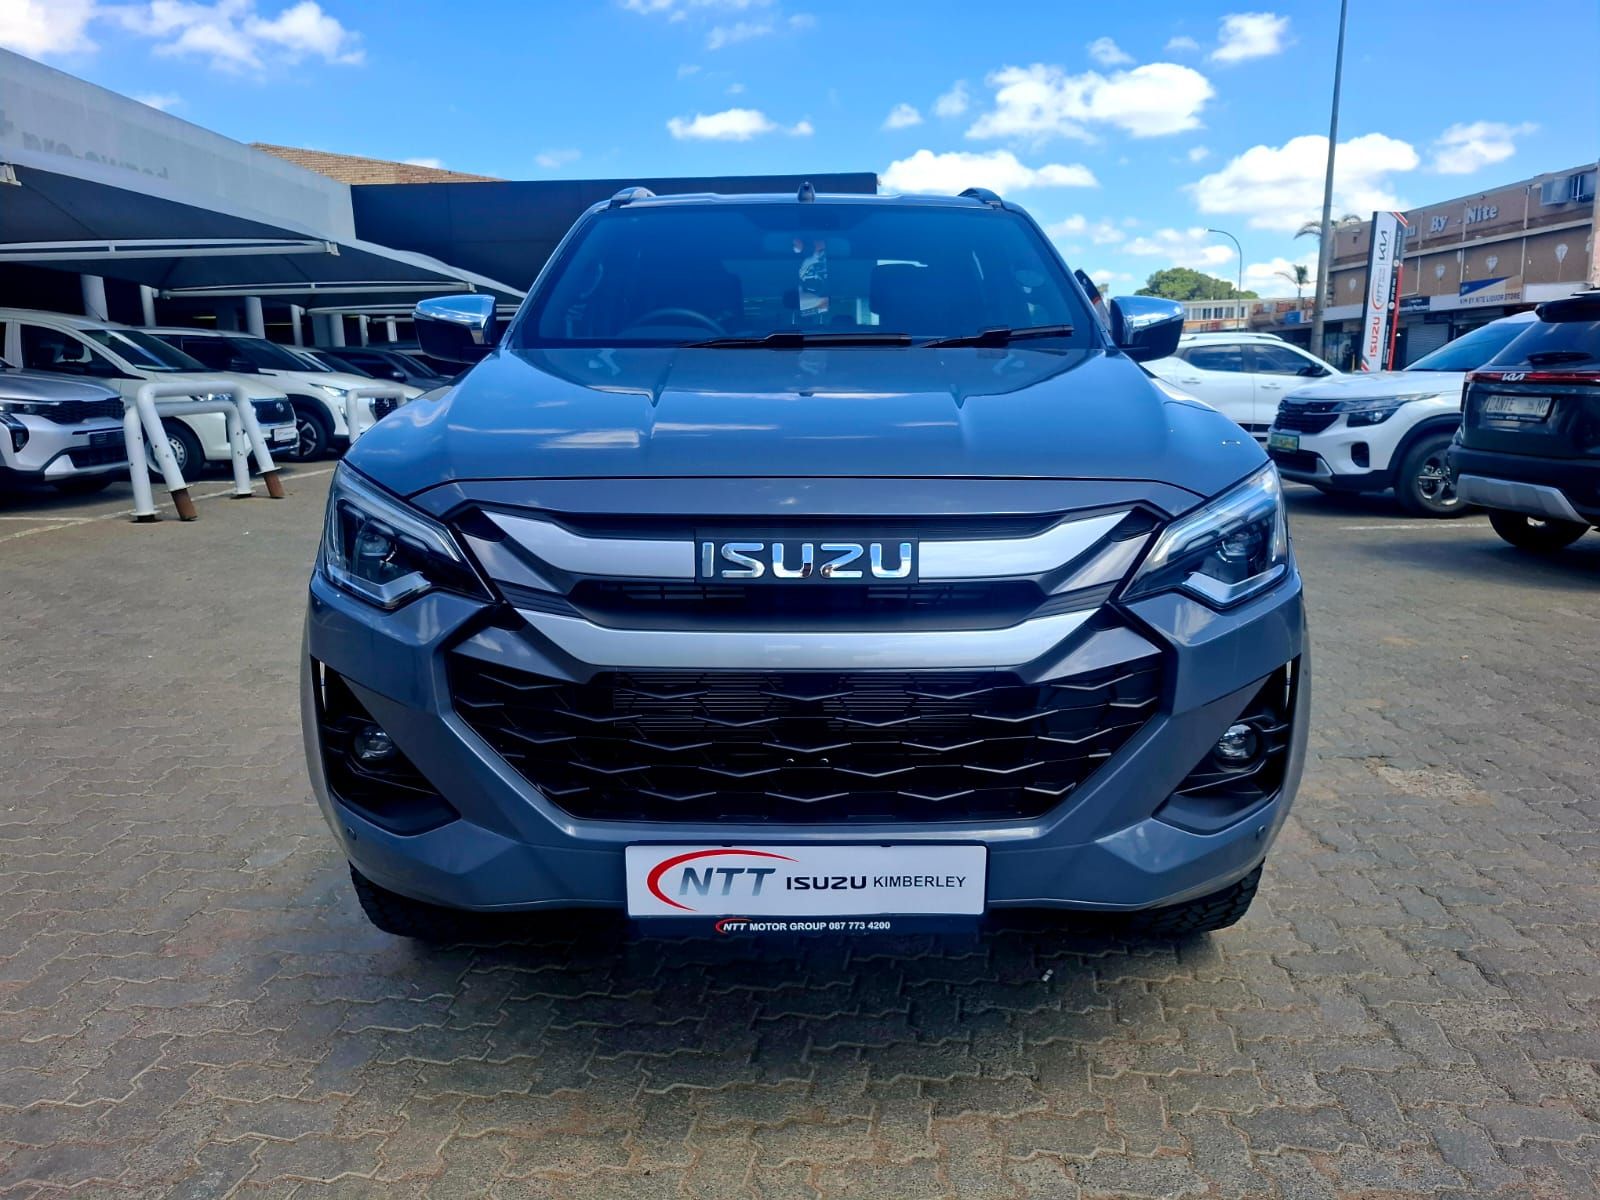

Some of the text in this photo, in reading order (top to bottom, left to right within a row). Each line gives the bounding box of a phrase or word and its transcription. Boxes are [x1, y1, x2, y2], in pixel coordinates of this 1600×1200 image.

[1430, 215, 1448, 233] By
[1465, 205, 1498, 225] Nite
[1369, 317, 1380, 357] ISUZU
[702, 541, 912, 578] ISUZU
[679, 867, 967, 896] NTT ISUZU KIMBERLEY
[723, 921, 891, 932] NTT MOTOR GROUP 087 773 4200
